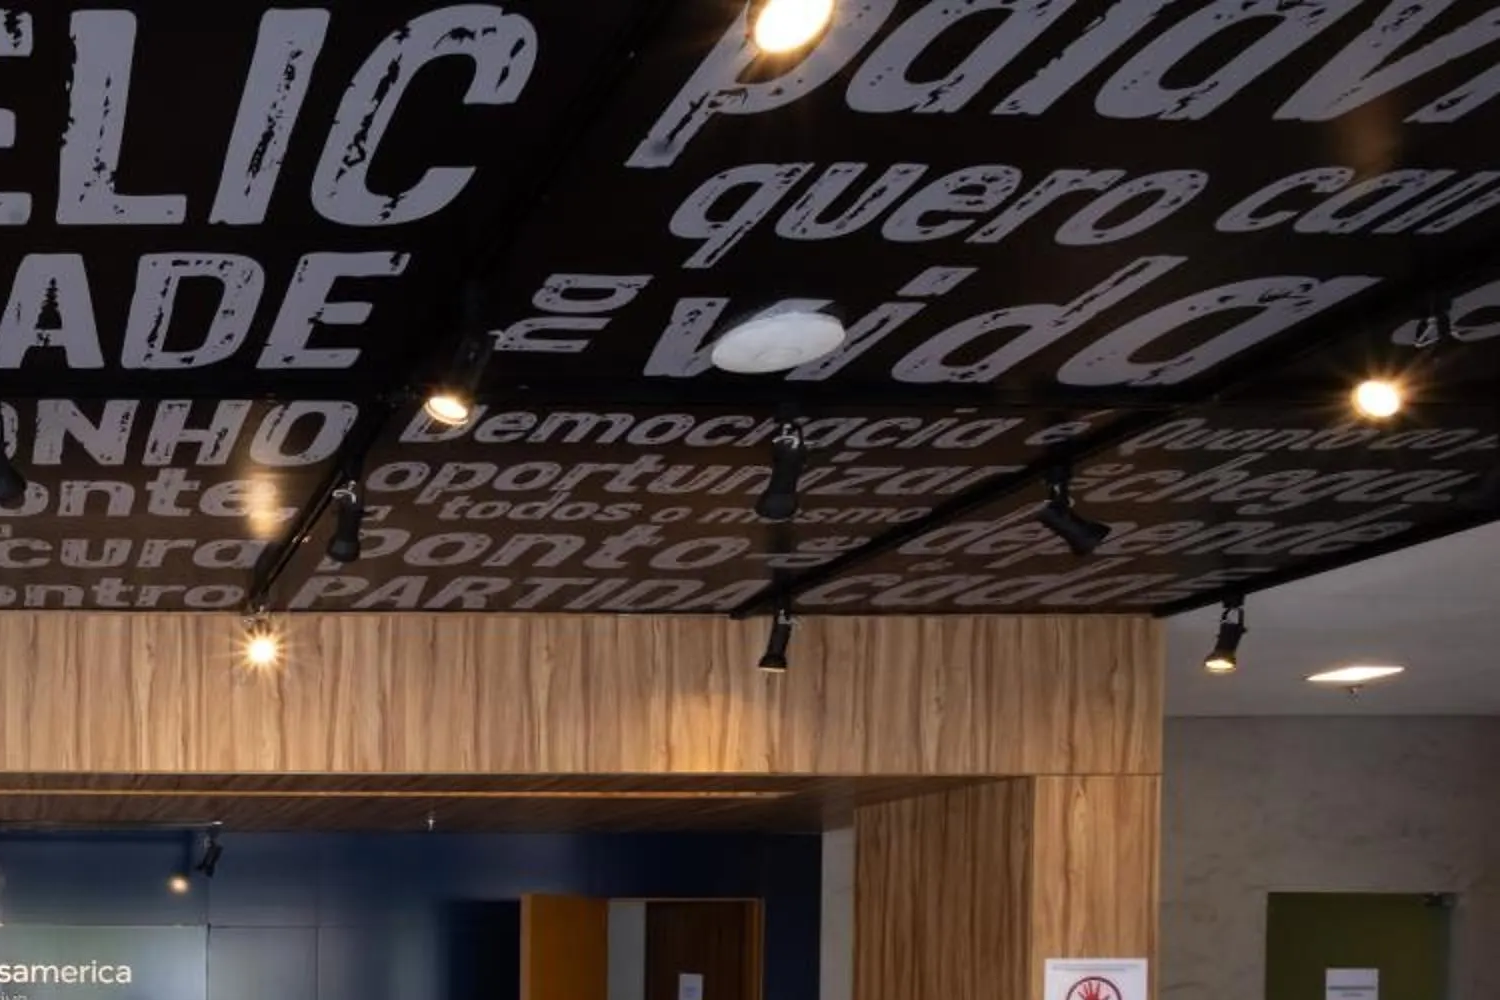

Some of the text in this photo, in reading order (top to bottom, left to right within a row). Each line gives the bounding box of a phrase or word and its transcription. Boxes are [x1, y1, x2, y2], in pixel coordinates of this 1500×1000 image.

[669, 162, 1208, 268] quero
[438, 491, 642, 522] todos
[651, 507, 692, 523] o
[699, 507, 934, 523] msmo
